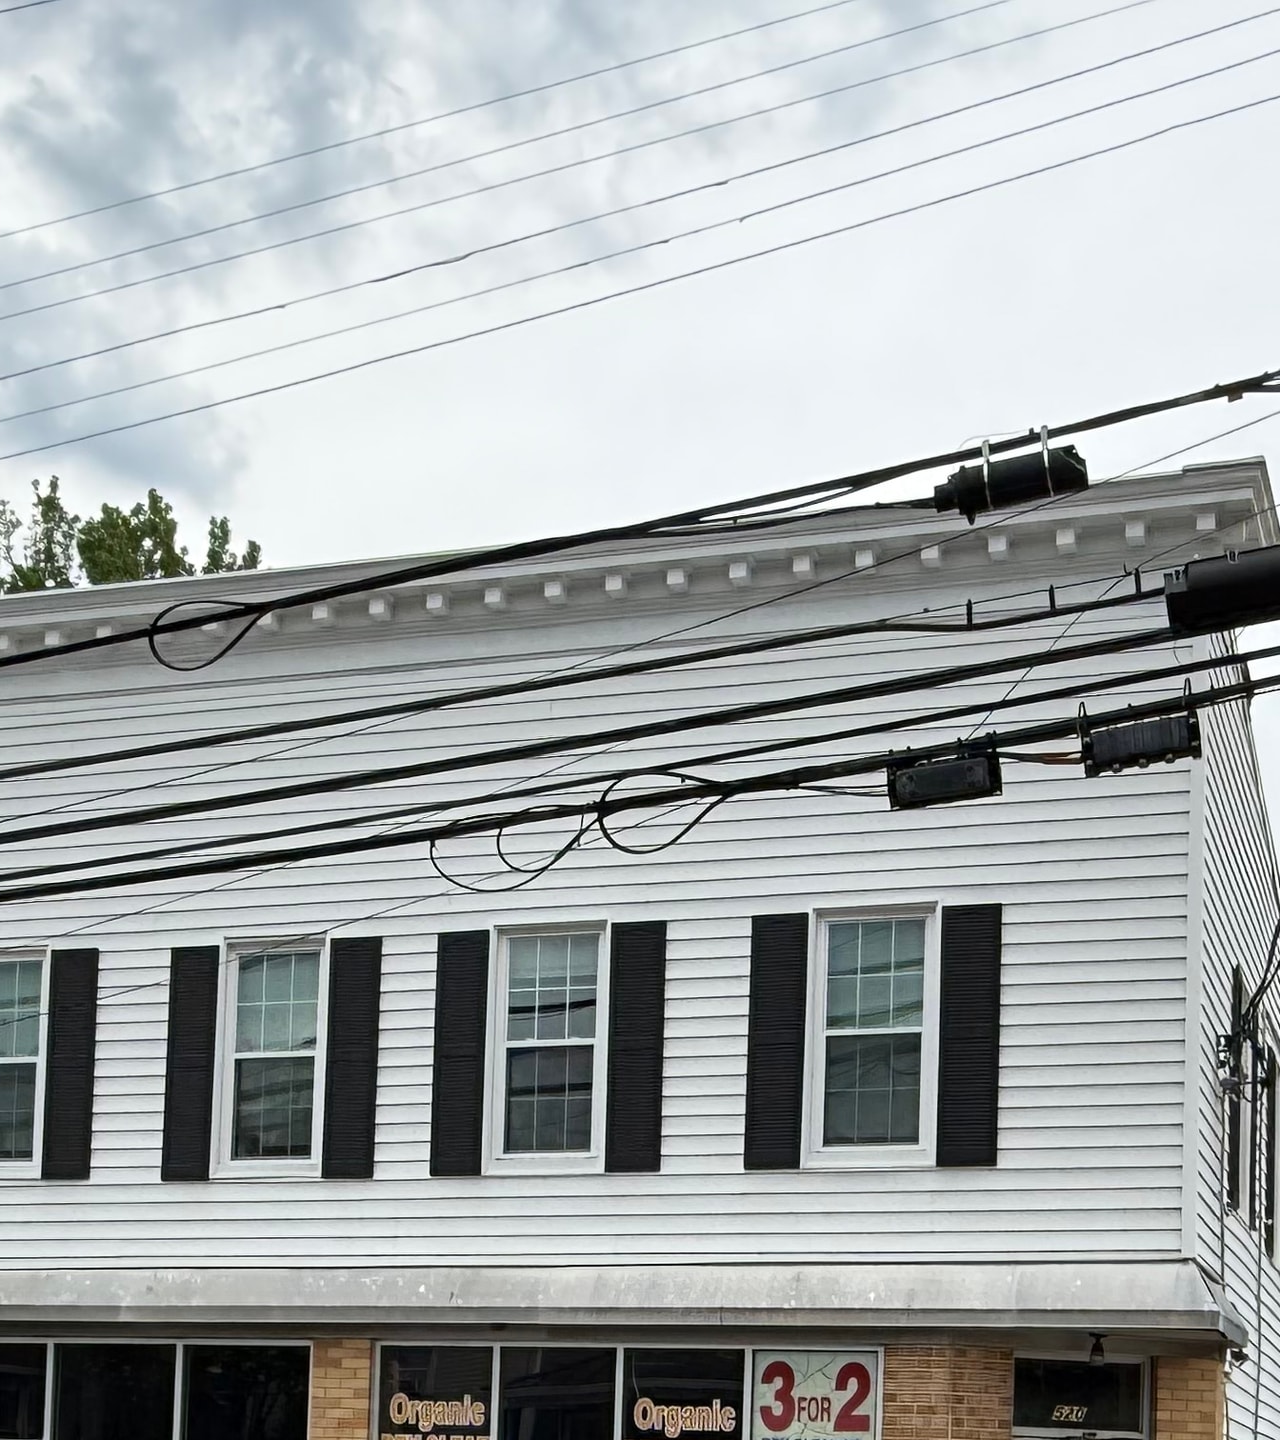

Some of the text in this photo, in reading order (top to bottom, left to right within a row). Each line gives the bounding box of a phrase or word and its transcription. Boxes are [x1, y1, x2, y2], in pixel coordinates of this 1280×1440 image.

[389, 1392, 486, 1432] Organic
[760, 1361, 871, 1432] 3 FOR 2
[634, 1397, 736, 1438] Organic
